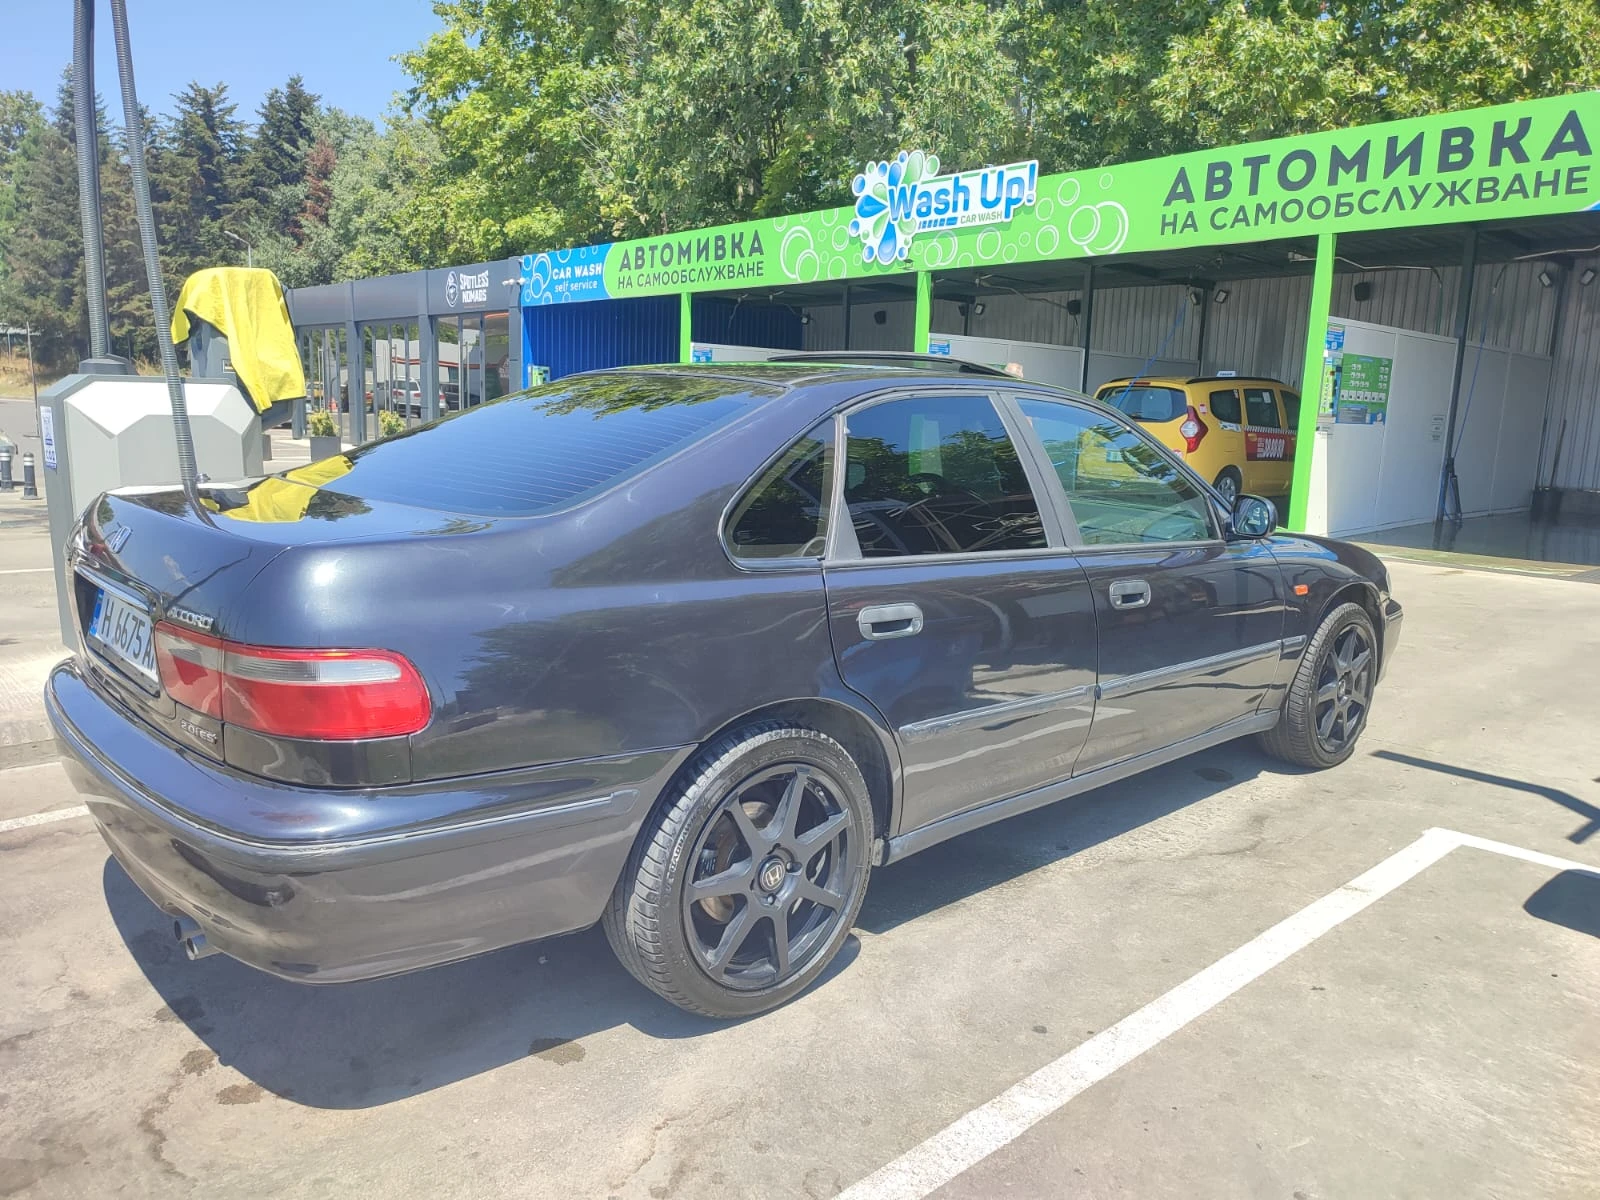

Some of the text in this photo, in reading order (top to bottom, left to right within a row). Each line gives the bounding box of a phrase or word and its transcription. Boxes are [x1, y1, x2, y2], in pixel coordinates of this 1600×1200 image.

[1163, 110, 1592, 206] АВТОМИВКА
[888, 163, 1036, 221] Wash Up!
[1160, 165, 1591, 235] НА САМООБСЛУЖВАНЕ
[960, 211, 1002, 225] CAR WASH
[619, 229, 764, 272] АВТОМИВКА
[459, 270, 489, 290] SPOTLESS
[552, 262, 602, 280] CAR WASH
[617, 261, 764, 290] НА САМООБСЛУЖВАНЕ
[462, 289, 487, 303] NOMADS
[555, 280, 598, 293] self service
[102, 599, 114, 638] H
[115, 607, 145, 660] 6675
[167, 606, 213, 629] ACCORD
